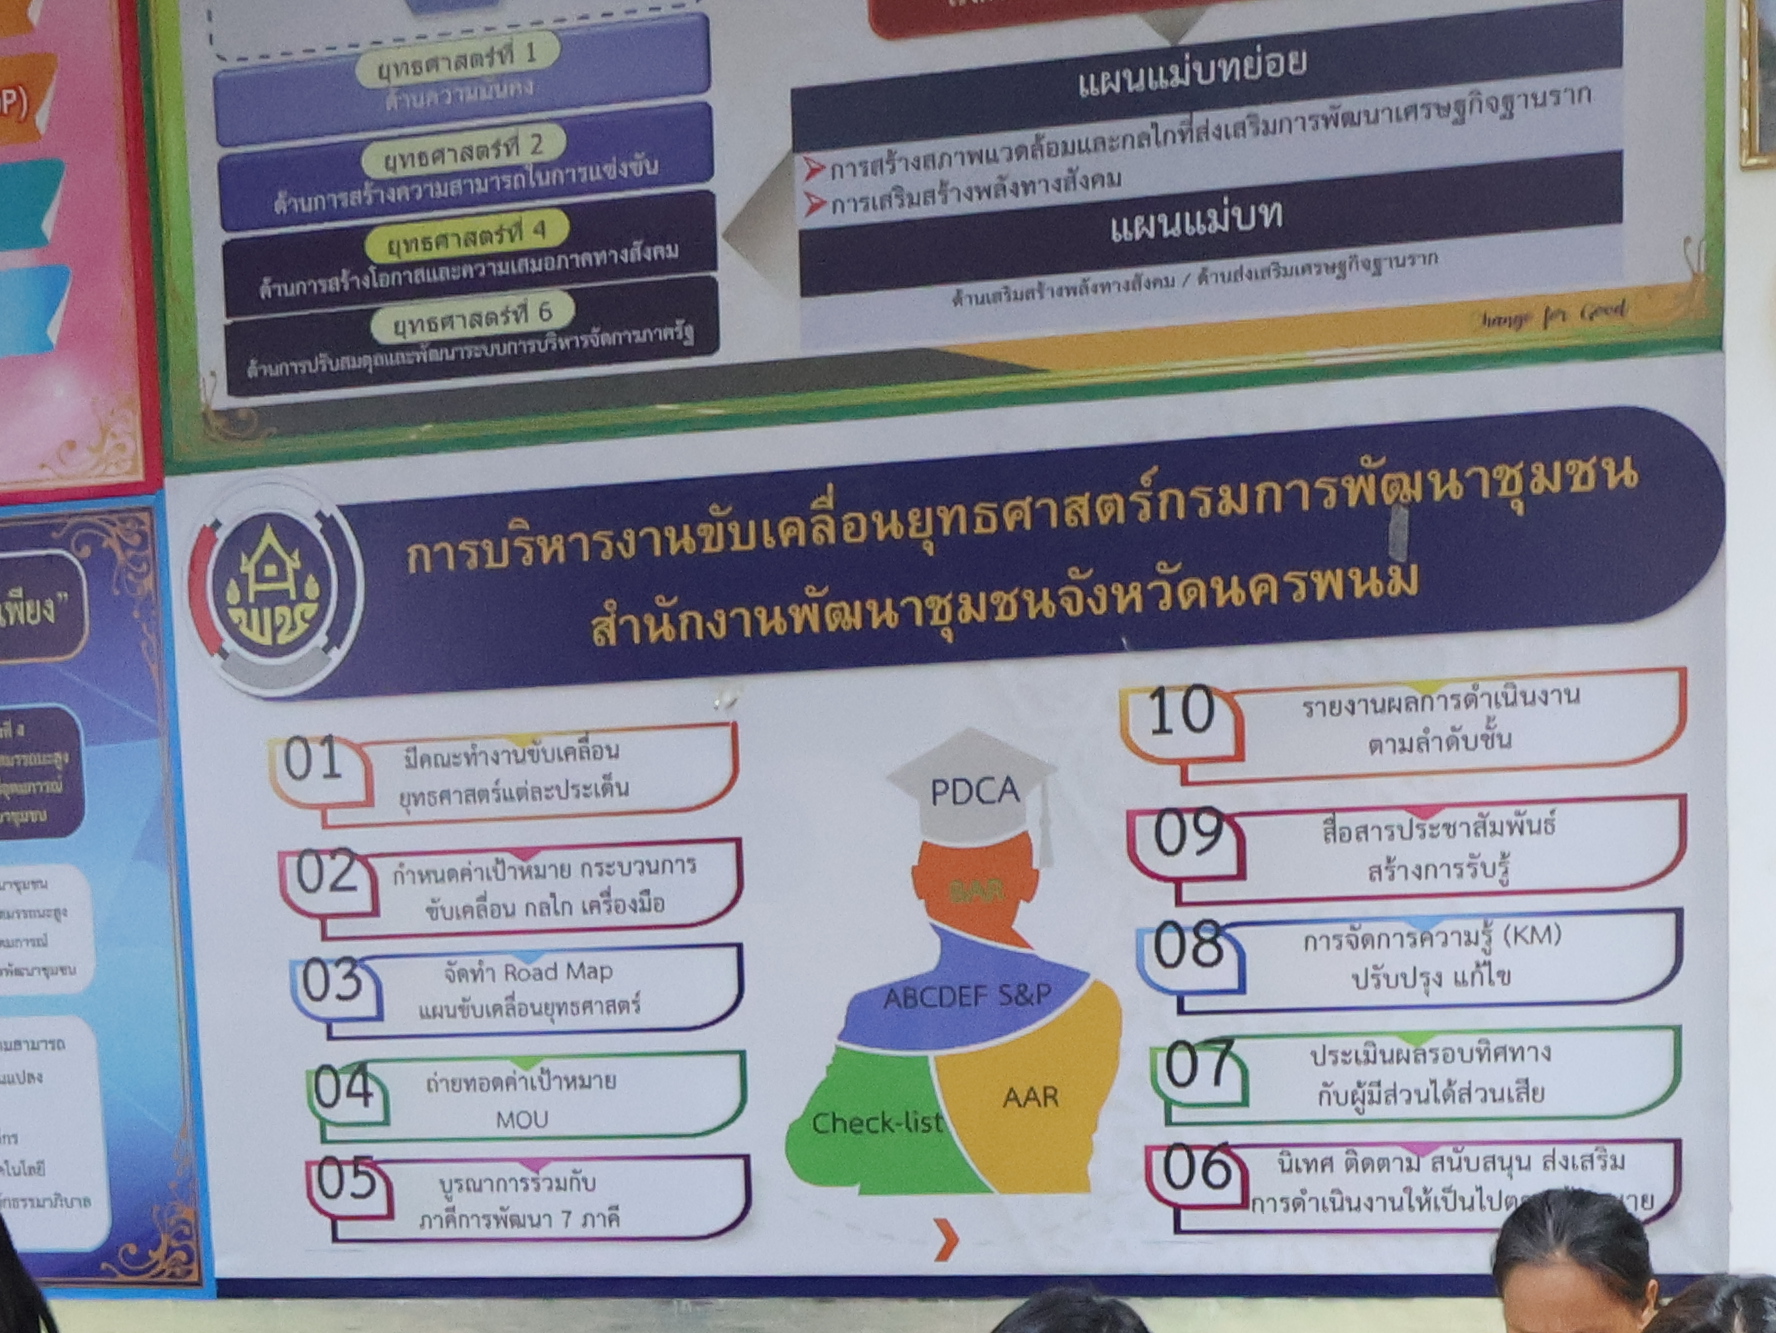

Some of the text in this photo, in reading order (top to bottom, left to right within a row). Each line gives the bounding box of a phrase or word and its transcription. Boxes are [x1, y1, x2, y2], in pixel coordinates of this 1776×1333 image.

[377, 42, 538, 81] ยุทธศาสตร์ที่ 1
[1077, 46, 1310, 100] แผนแม่บทย่อย
[383, 133, 544, 172] ยุทธศาสตร์ที่ 2
[830, 165, 1124, 216] การเสริมสร้างพลังทางสังคม
[387, 220, 547, 257] ยุทธศาสตร์ที่ 4
[1110, 197, 1285, 246] แผนแม่บท
[951, 247, 1440, 309] ด้านเสริมสร้างพลังทางสังคม ด้านส่งเสริมเศรษฐกิจฐานราก
[392, 301, 553, 339] ยุทธศาสตร์ที่ 6
[404, 446, 1641, 579] การบริหารงานขับเคลื่อนยุทธศาสตร์กรมการพัฒนาชุมชน
[589, 554, 1422, 653] สำนักงานพัฒนาชุมชนจังหวัดนครพนม
[1149, 684, 1581, 735] 10 รายงานผลการดำเนินงาน
[1369, 715, 1513, 755] ตามลำดับชั้น
[284, 732, 620, 781] 01 มีคณะทำงานขับเคลื่อน
[399, 777, 630, 815] ยุทธศาสตร์แต่ละประเด็น
[931, 775, 1021, 807] PDCA
[1154, 806, 1557, 856] 09 สื่อสารประชาสัมพันธ์
[296, 847, 697, 894] 02 กำหนดค่าเป้าหมาย กระบวนการ
[1368, 851, 1511, 887] สร้างการรับรู้
[425, 888, 665, 922] ขับเคลื่อน กลไก เครื่องมือ
[1154, 918, 1562, 969] 08 การจัดการความรู้ (KM)
[302, 956, 613, 1003] 03 จัดทำ Road Map
[1352, 957, 1512, 996] ปรับปรุง แก้ไข
[419, 991, 641, 1026] แผนขับเคลื่อนยุทธศาสตร์
[883, 983, 1052, 1011] ABCDEF S&P
[1166, 1038, 1551, 1088] 07 ประเมินผลรอบทิศทาง
[314, 1063, 617, 1110] 04 ถ่ายทอดค่าเป้าหมาย
[1003, 1086, 1059, 1109] AAR
[1318, 1076, 1546, 1115] กับผู้มีส่วนได้ส่วนเสีย
[496, 1110, 549, 1130] MOU
[812, 1111, 944, 1135] Check-list
[317, 1155, 596, 1201] 05 บูรณาการร่วมกับ
[1163, 1142, 1626, 1191] 06 นิเทศ ติดตาม สนับสนุน ส่งเสริม
[419, 1203, 620, 1230] ภาคีการพัฒนา 7 ภาคี
